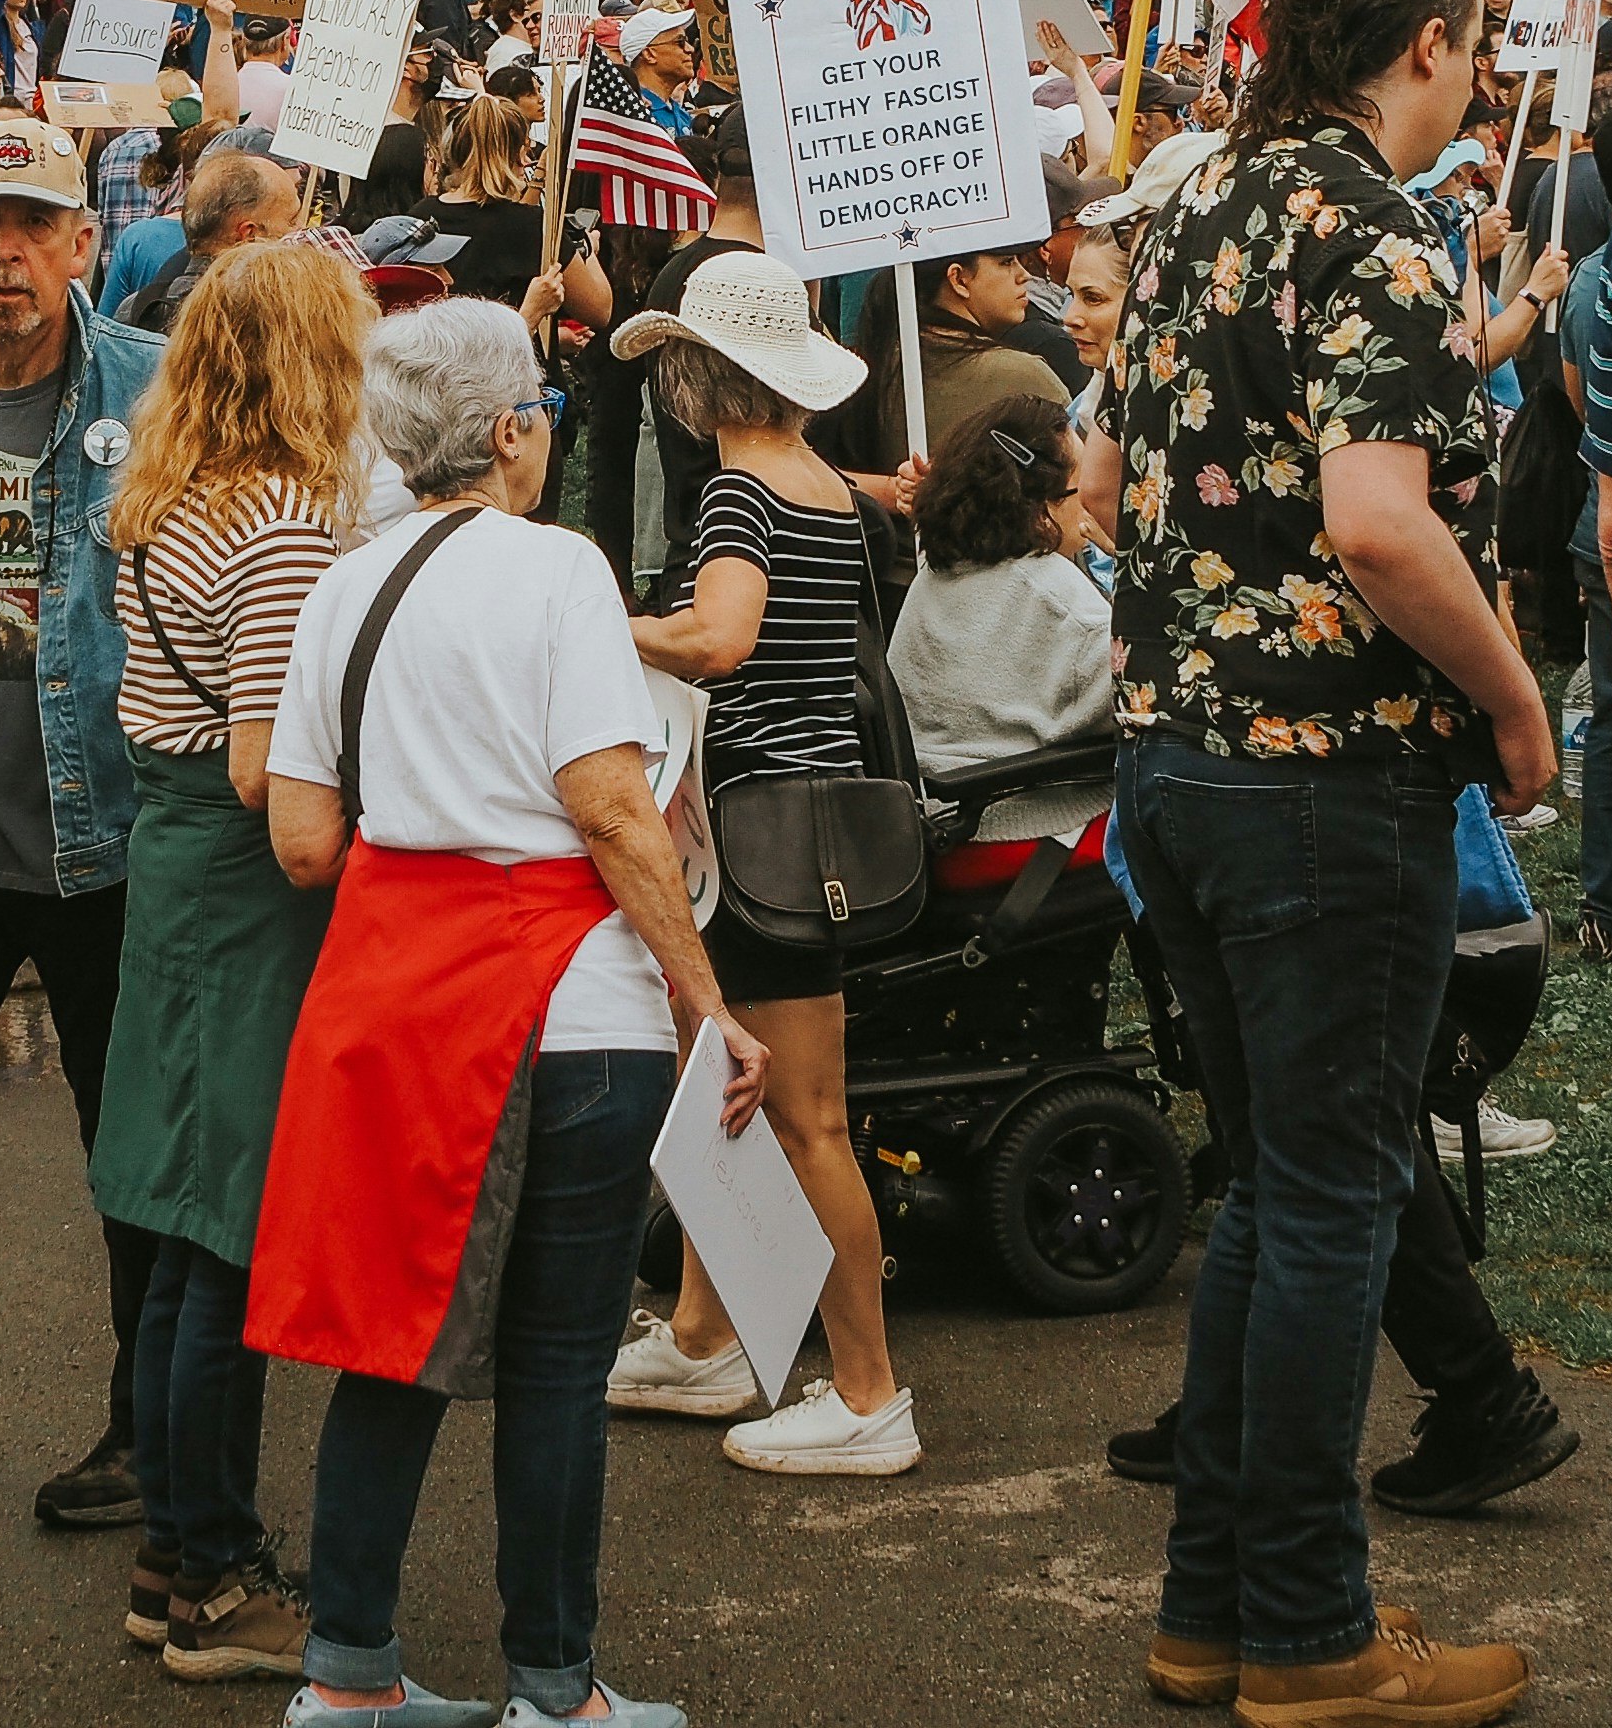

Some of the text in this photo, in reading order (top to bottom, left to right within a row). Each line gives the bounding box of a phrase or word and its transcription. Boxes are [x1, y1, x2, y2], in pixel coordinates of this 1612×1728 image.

[79, 3, 166, 52] Pressure!
[543, 35, 579, 59] AMERI
[295, 32, 360, 94] Depends
[822, 49, 942, 85] GET YOUR
[327, 97, 376, 153] Freedom
[791, 77, 980, 126] FILTHY FASCIST
[798, 112, 986, 161] LITTLE ORANGE
[808, 148, 985, 195] HANDS OFF OF
[819, 182, 989, 229] DEMOCRACY!!
